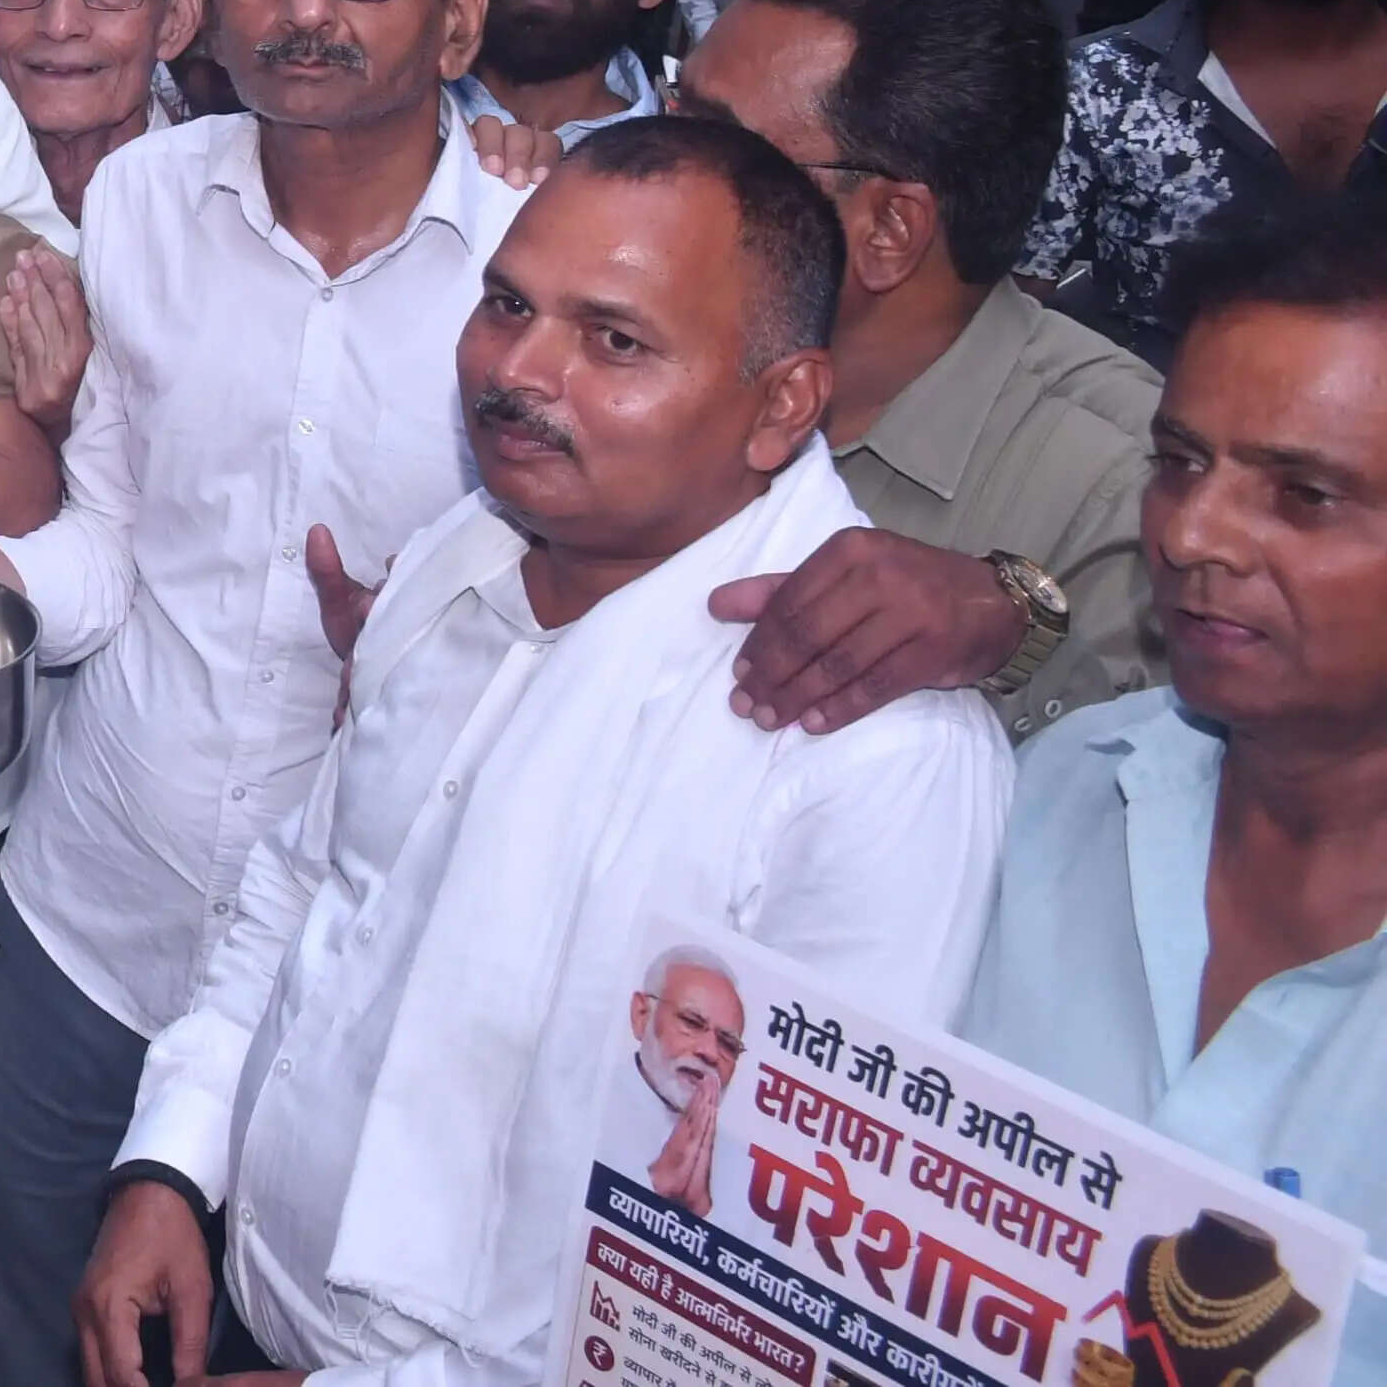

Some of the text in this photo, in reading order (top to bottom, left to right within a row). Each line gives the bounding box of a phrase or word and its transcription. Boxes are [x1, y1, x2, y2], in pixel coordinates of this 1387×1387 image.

[755, 1061, 1103, 1278] सराफा व्यवसाय
[767, 1001, 1123, 1211] मोदी जी की अपील से
[598, 1242, 805, 1373] क्या यही है आत्मनिर्भर भारत?
[608, 1187, 711, 1269] व्यापारियों,
[717, 1247, 835, 1328] कर्मचारियों
[836, 1307, 885, 1359] और
[746, 1141, 1068, 1383] परेशान
